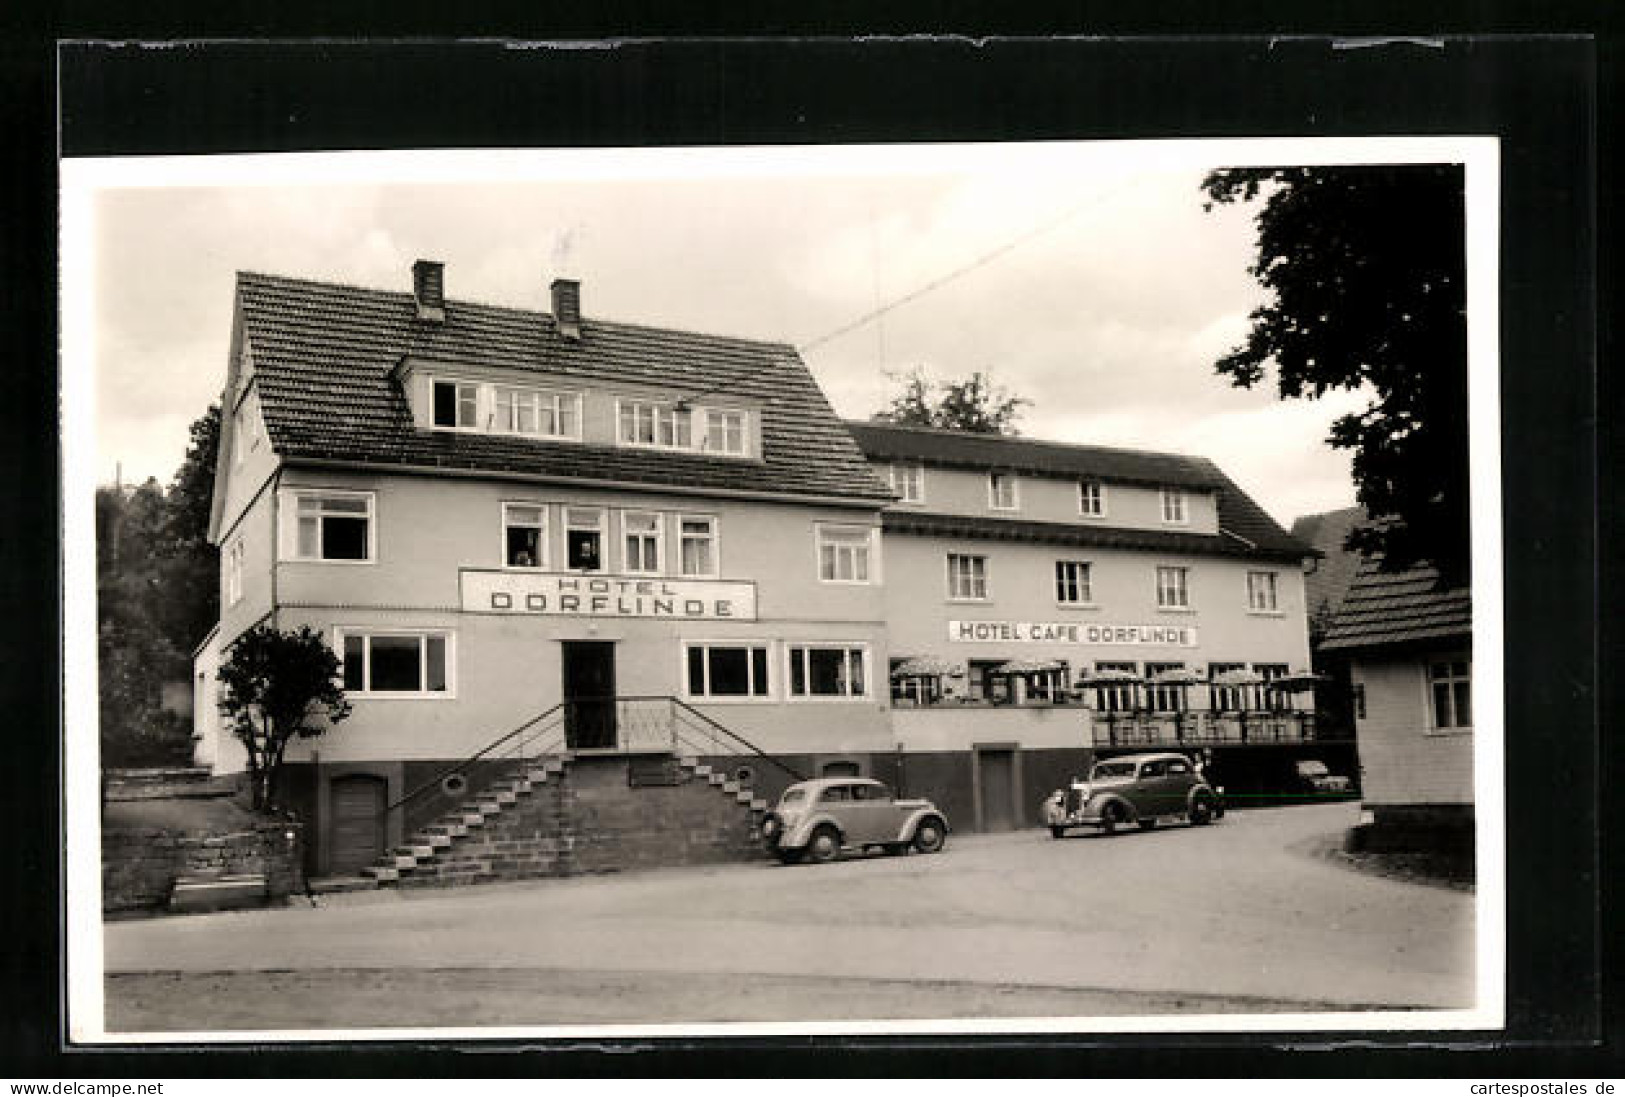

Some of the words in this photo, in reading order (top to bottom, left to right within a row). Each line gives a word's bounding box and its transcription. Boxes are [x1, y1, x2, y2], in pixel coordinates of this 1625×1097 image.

[558, 578, 678, 595] HOTEL
[490, 591, 733, 617] DORFLINDE
[959, 622, 1021, 640] HOTEL
[1088, 626, 1189, 645] DORFLINDE
